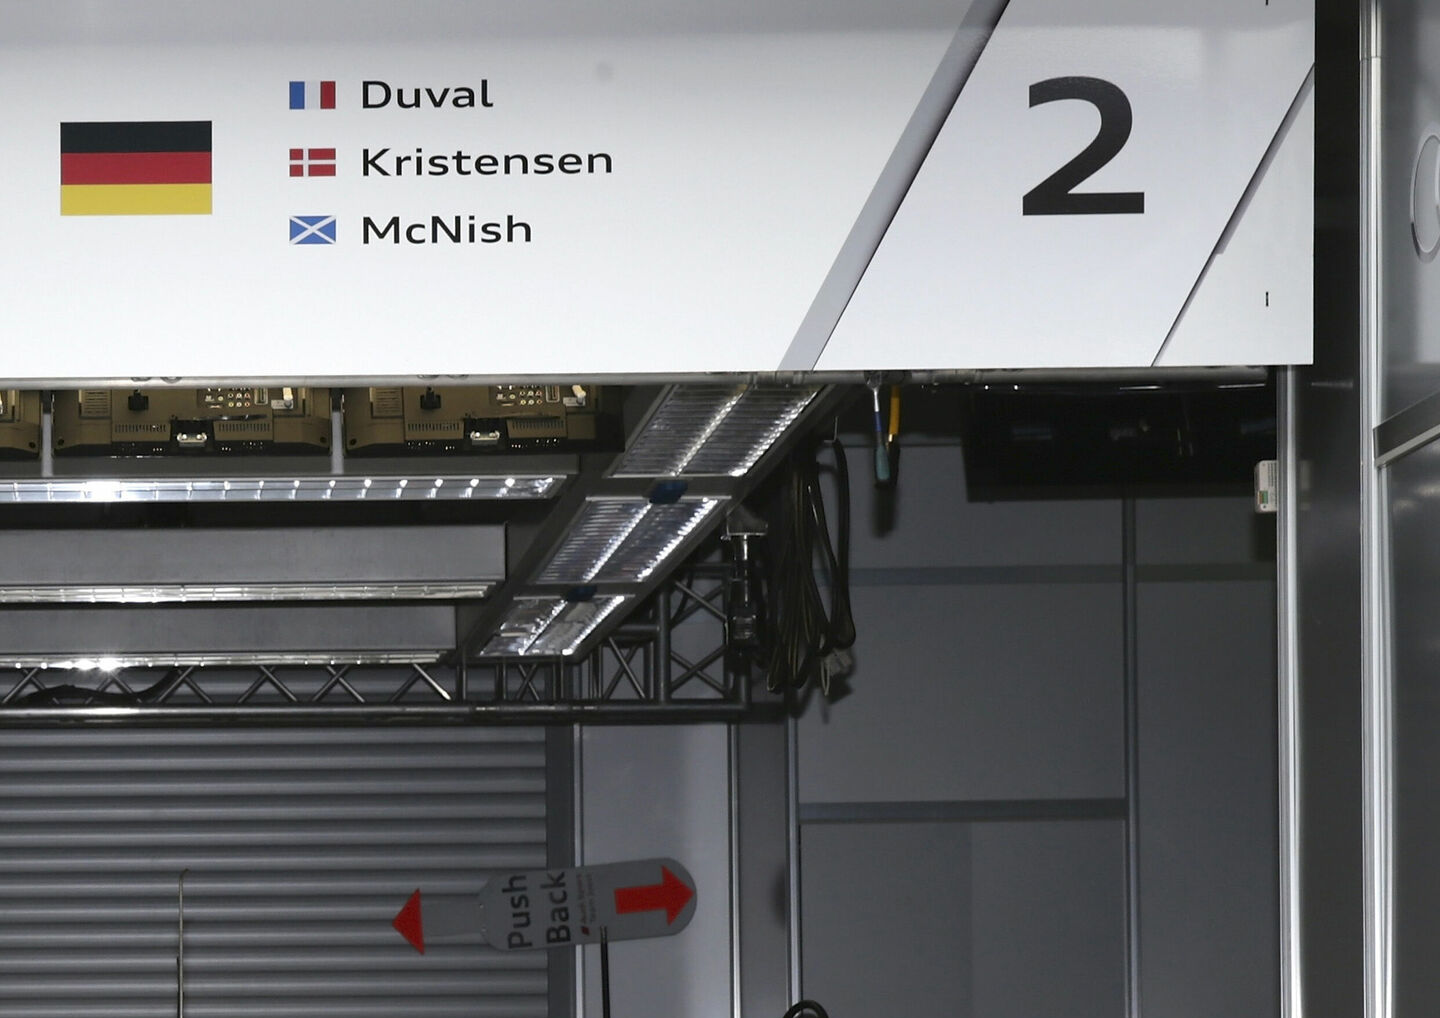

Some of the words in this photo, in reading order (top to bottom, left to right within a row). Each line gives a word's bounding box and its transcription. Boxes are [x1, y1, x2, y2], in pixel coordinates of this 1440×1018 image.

[361, 78, 493, 110] Duval
[361, 145, 614, 179] Kristensen
[1023, 76, 1145, 216] 2
[361, 213, 532, 246] McNish
[501, 874, 533, 950] Push
[540, 871, 572, 944] Back
